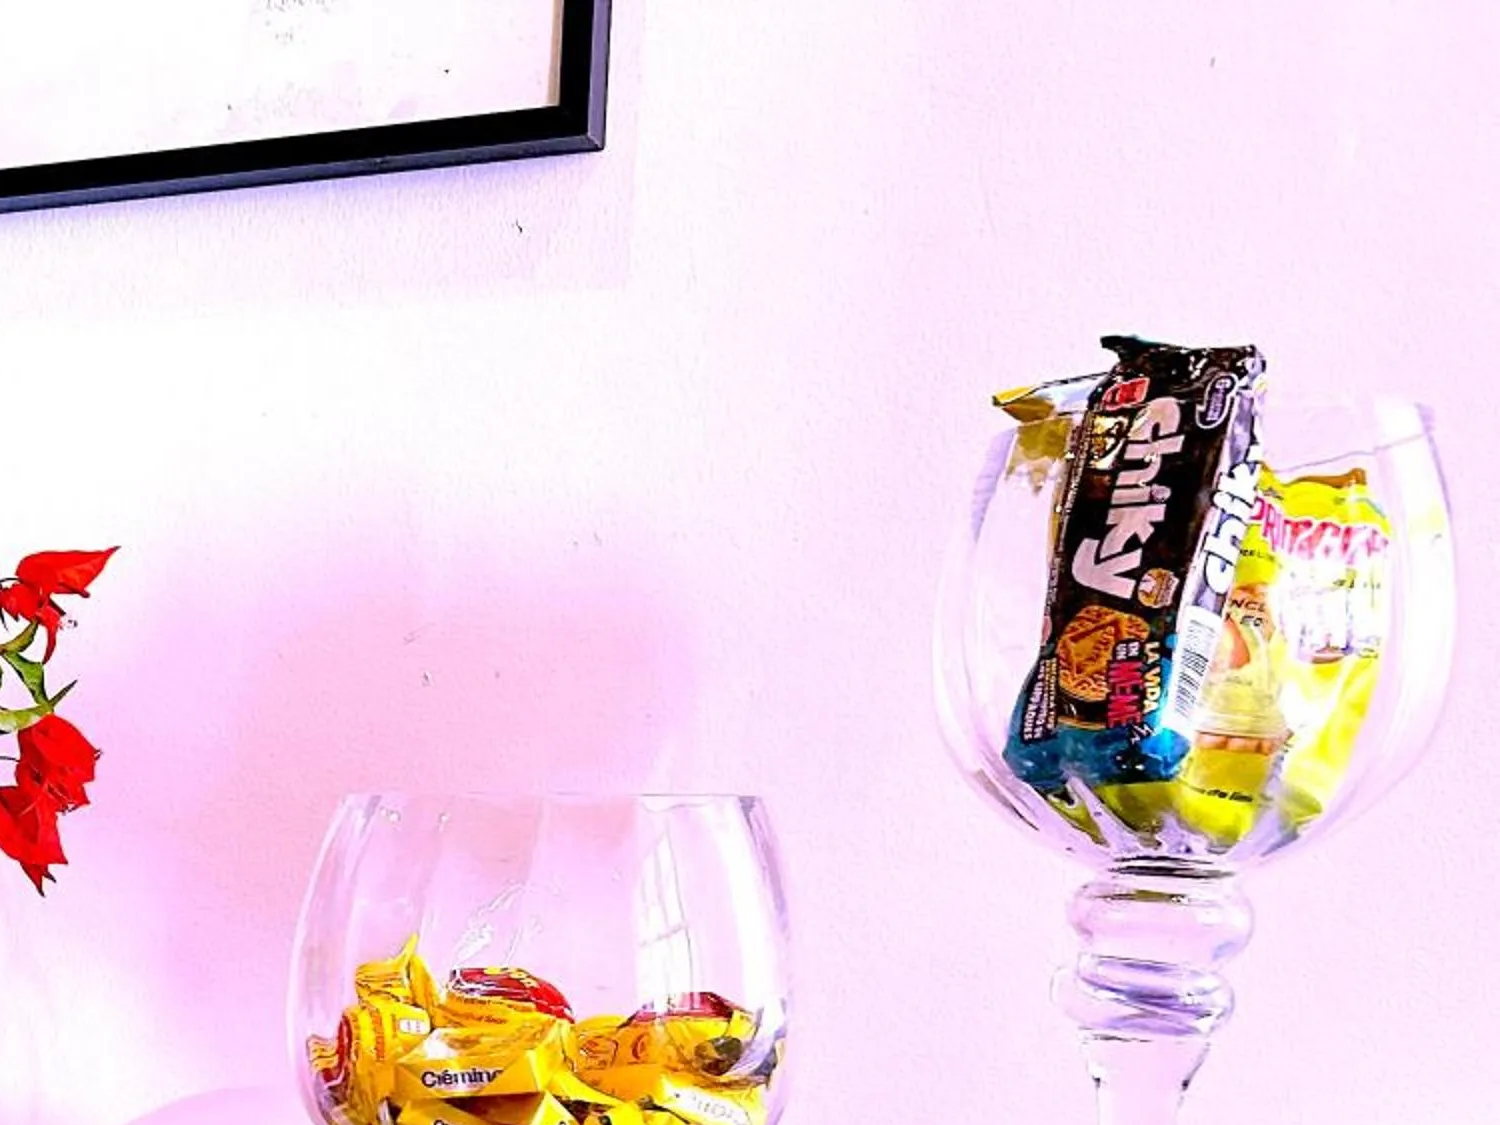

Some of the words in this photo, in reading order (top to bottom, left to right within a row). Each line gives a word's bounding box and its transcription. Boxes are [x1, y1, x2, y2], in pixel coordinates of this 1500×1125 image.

[1144, 641, 1161, 664] LA
[1107, 661, 1144, 728] MEME
[1143, 665, 1162, 713] VIDA
